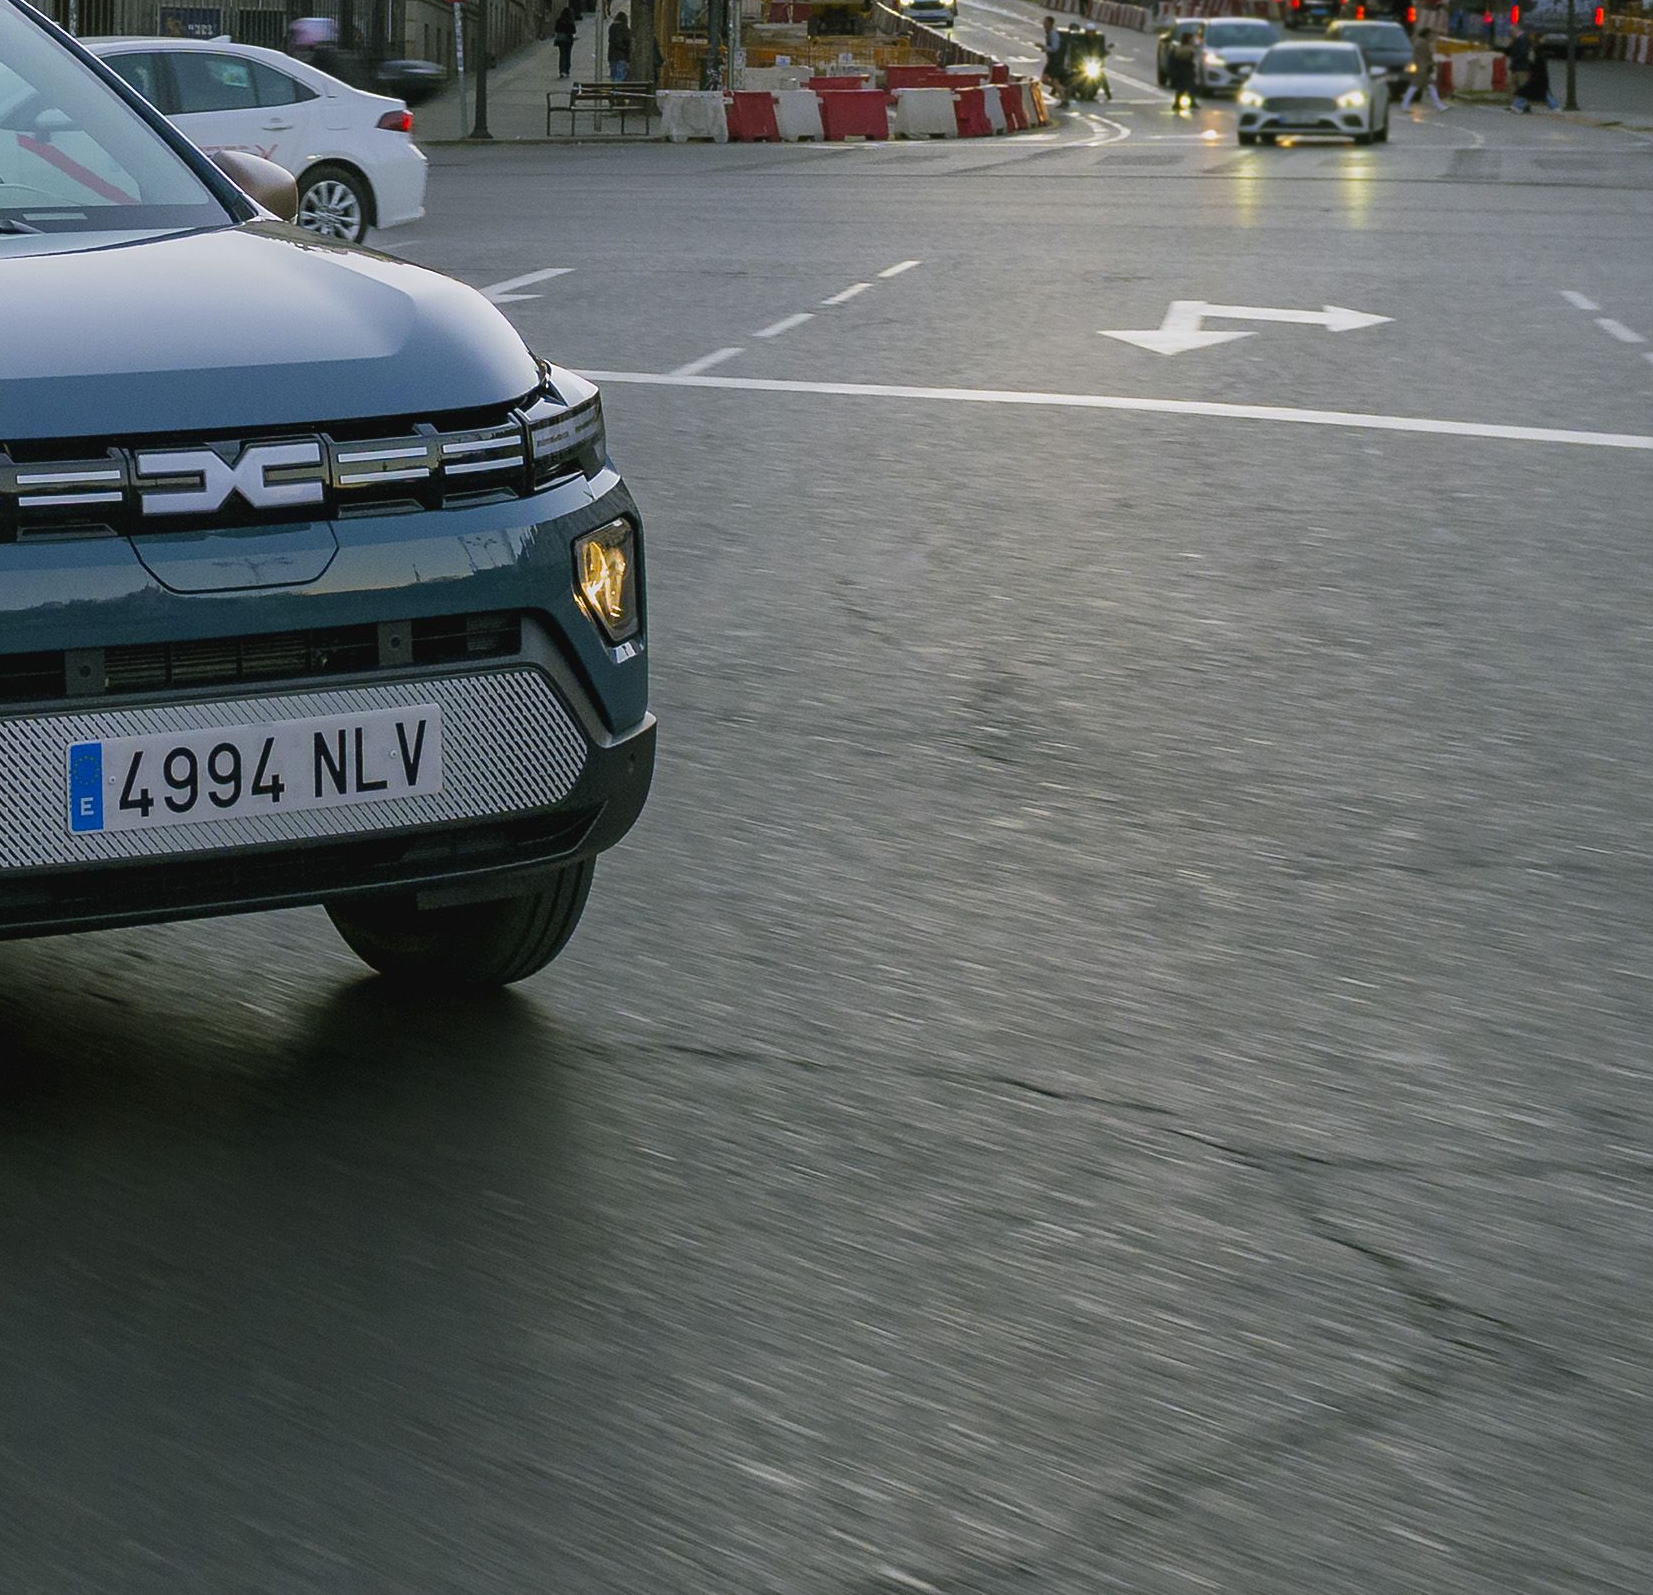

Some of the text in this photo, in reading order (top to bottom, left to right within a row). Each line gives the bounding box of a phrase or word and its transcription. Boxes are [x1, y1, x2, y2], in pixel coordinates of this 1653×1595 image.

[80, 719, 427, 818] E 4994 NLV
